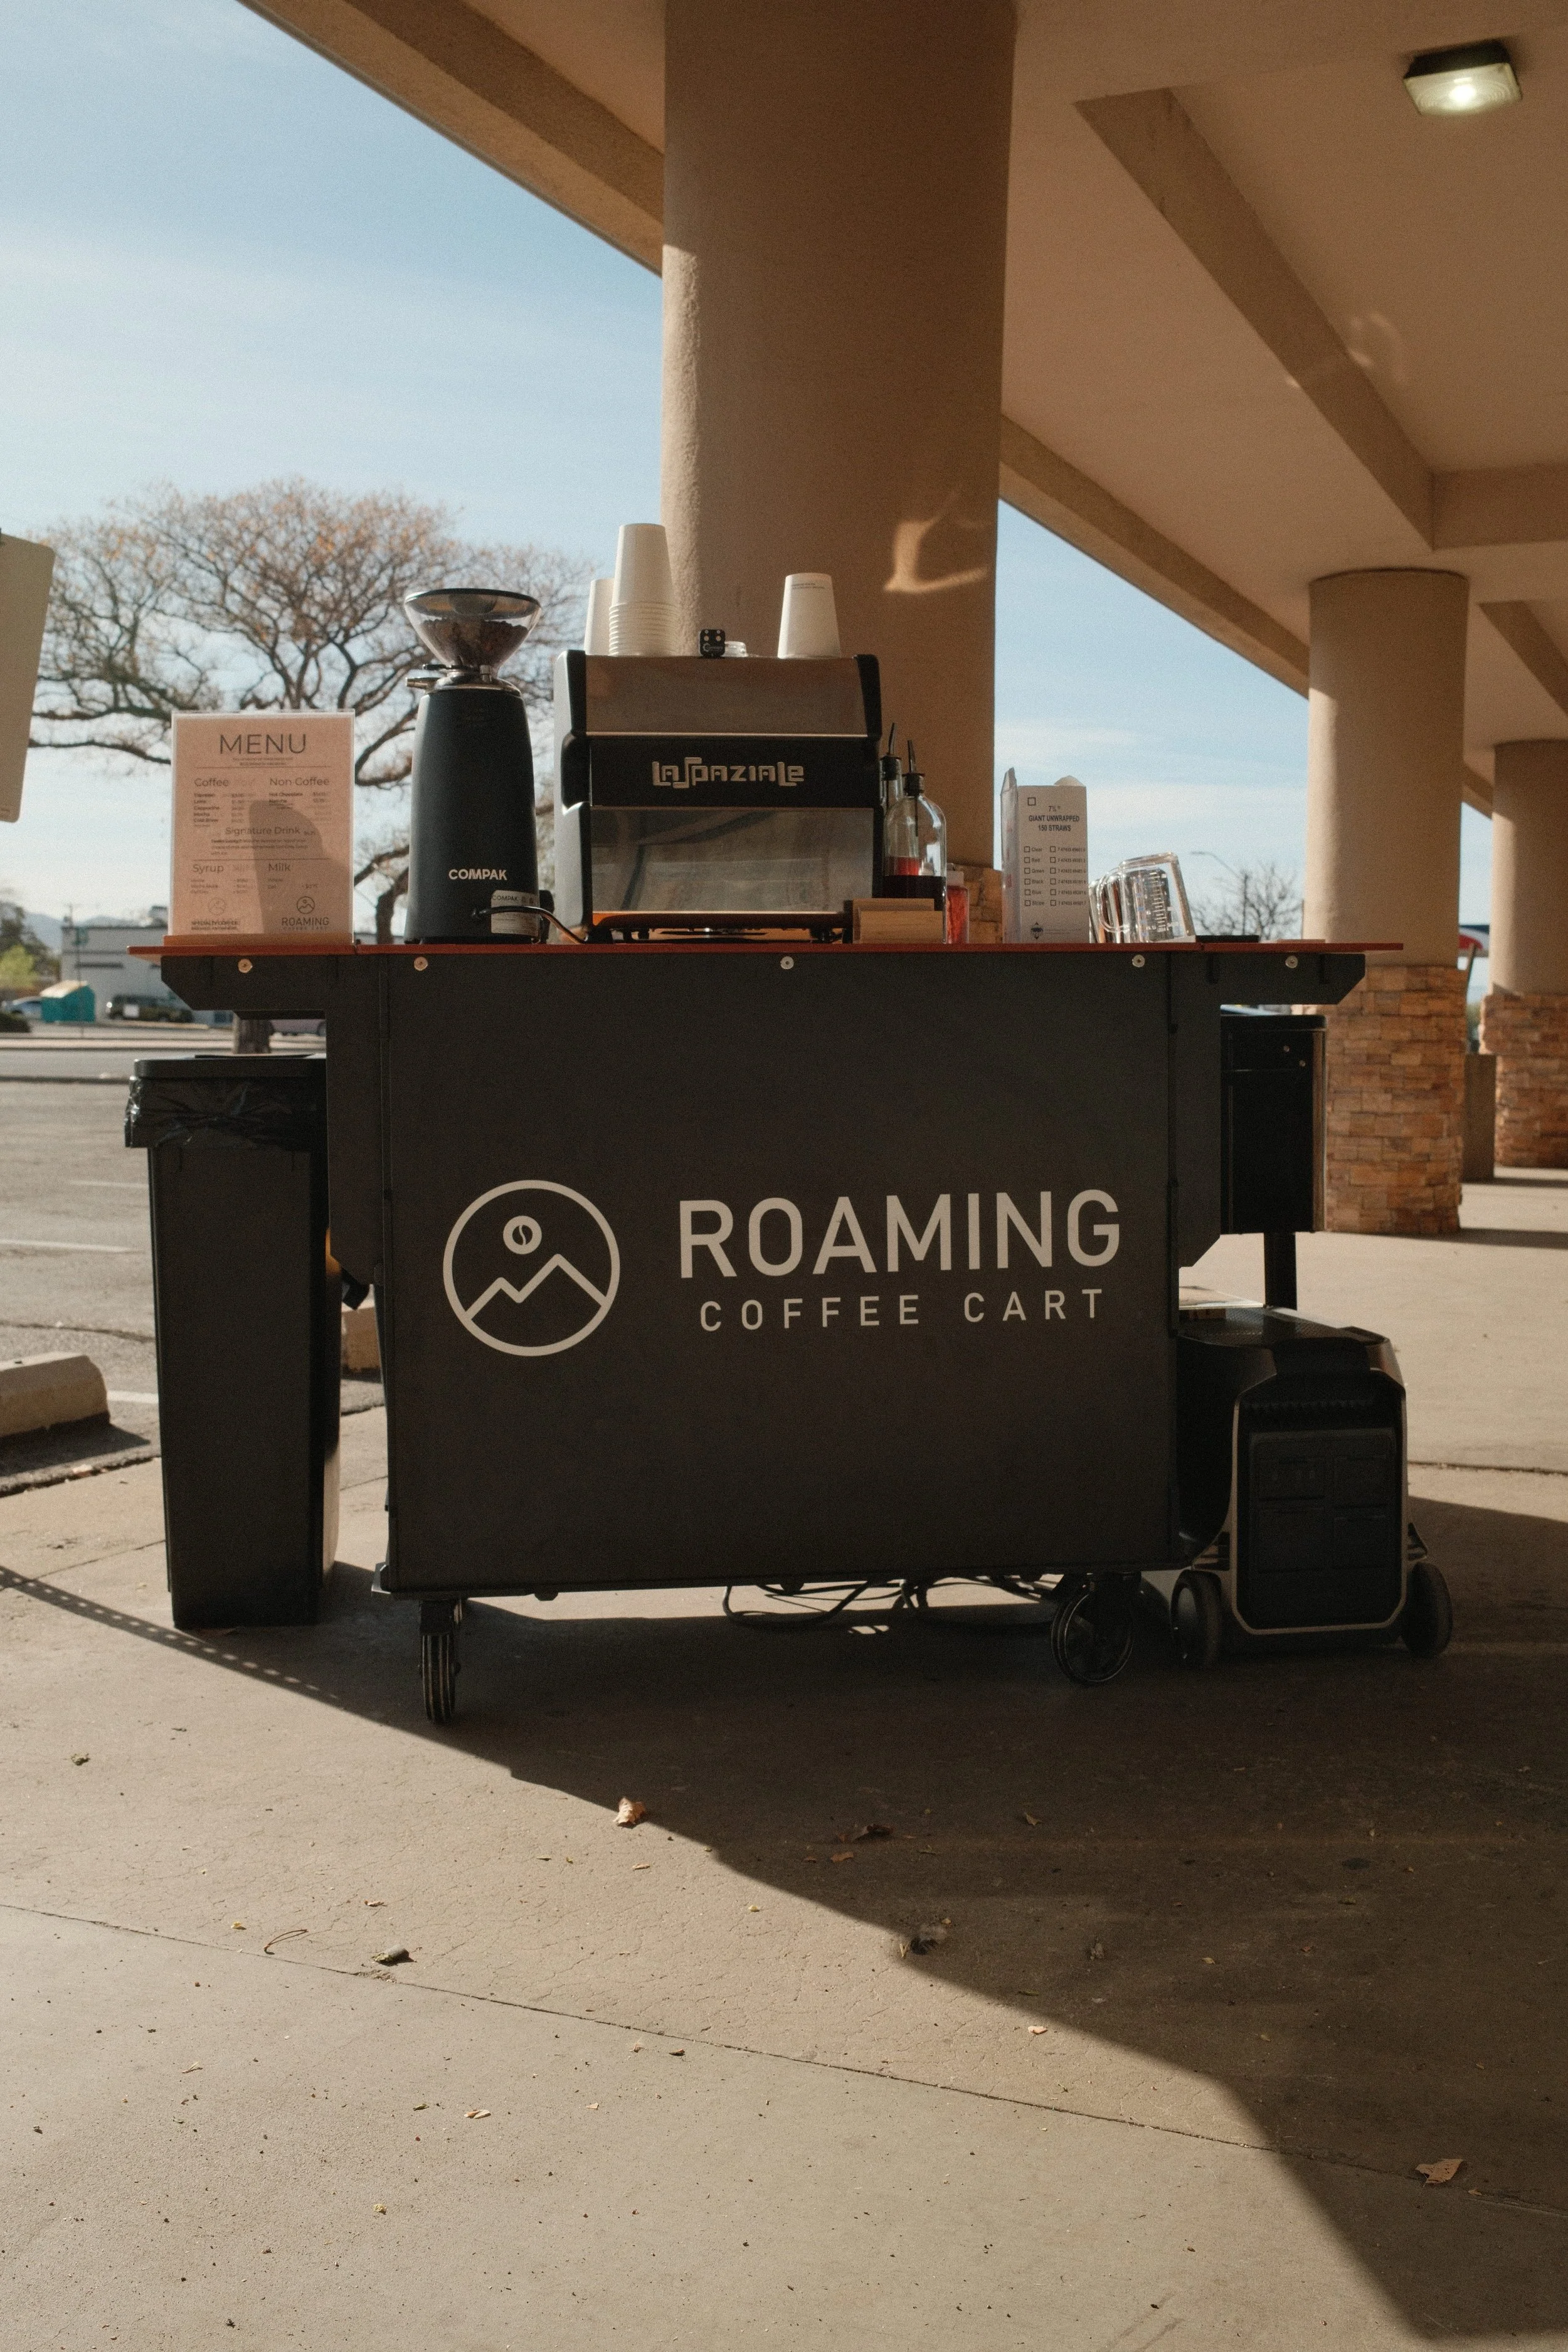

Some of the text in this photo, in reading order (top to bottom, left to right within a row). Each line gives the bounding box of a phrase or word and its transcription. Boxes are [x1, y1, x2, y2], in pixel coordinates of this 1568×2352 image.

[220, 733, 307, 755] MENU
[194, 777, 230, 787] Coffee
[270, 776, 330, 786] Non Coffee
[225, 827, 272, 837] Signature
[274, 826, 300, 835] Drink
[193, 864, 225, 874] Syrup
[268, 862, 291, 872] Milk
[448, 869, 507, 881] COMPAK
[282, 916, 330, 926] ROAMING
[679, 1189, 1120, 1278] ROAMING
[701, 1289, 1102, 1331] COFFEE CART
